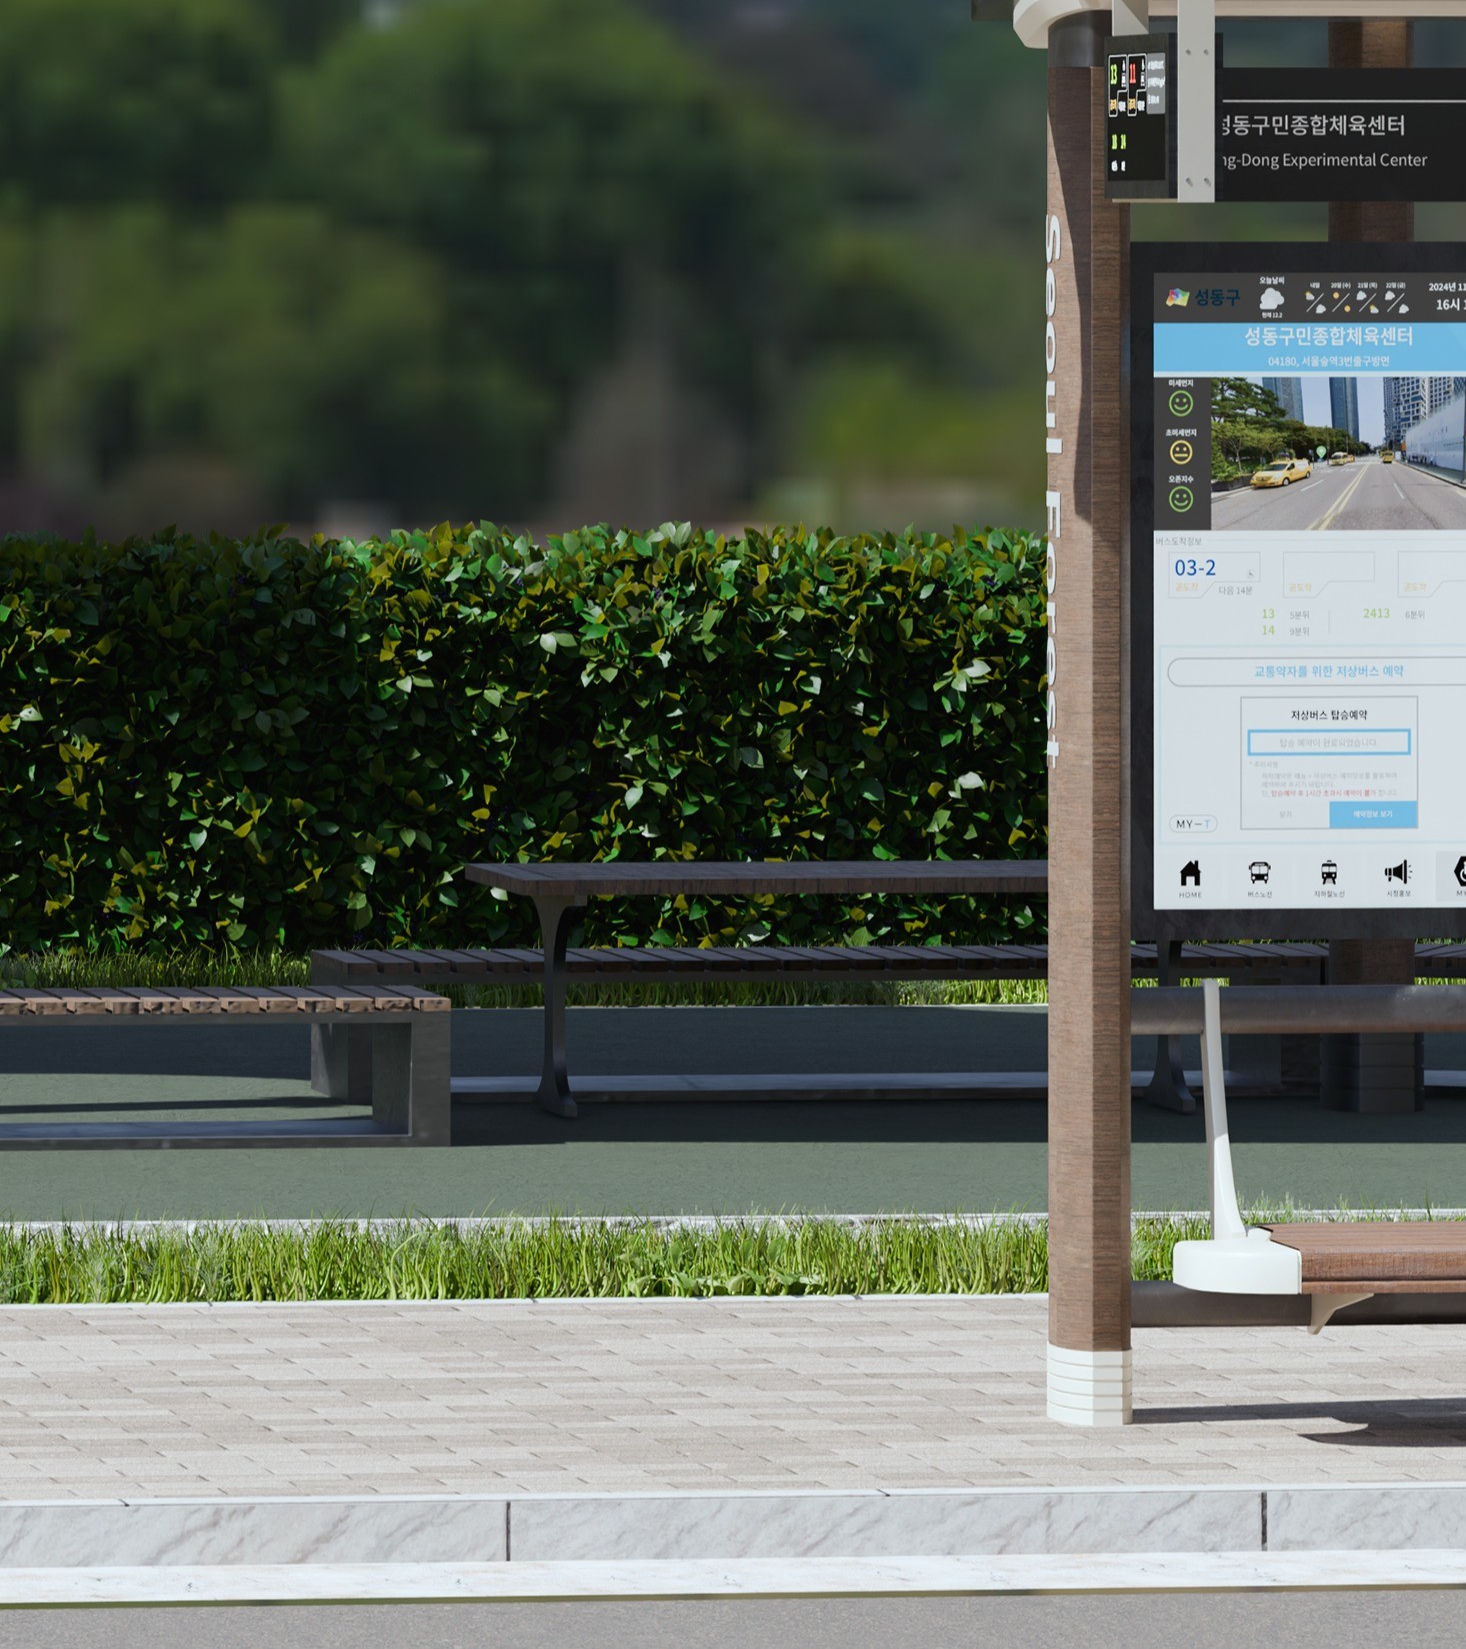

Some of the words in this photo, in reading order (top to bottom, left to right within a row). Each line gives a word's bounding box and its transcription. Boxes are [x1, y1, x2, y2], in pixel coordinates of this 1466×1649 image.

[1284, 153, 1376, 169] Experimental
[1380, 154, 1427, 166] Center
[1428, 281, 1457, 292] 2024년
[1196, 287, 1240, 306] 성동구
[1436, 297, 1460, 311] 16시
[1045, 213, 1062, 454] Seoul
[1244, 327, 1414, 346] 성동구민종합체육센터
[1268, 357, 1299, 368] 04180,
[1302, 356, 1390, 368] 서울숲역3번출구방면
[1168, 379, 1194, 388] 미세먼지
[1165, 428, 1197, 437] 초미세먼지
[1175, 560, 1215, 576] 03-2
[1218, 586, 1234, 596] 다음
[1236, 586, 1253, 596] 14분
[1262, 608, 1275, 619] 13
[1363, 608, 1390, 619] 2413
[1262, 624, 1276, 635] 14
[1255, 665, 1308, 679] 교통약자를
[1311, 665, 1333, 678] 위한
[1336, 665, 1379, 678] 저상버스
[1382, 665, 1404, 677] 예약
[1291, 710, 1328, 721] 저상버스
[1331, 709, 1367, 721] 탑승예약
[1179, 891, 1202, 899] HOME
[1247, 891, 1273, 899] 버스노선
